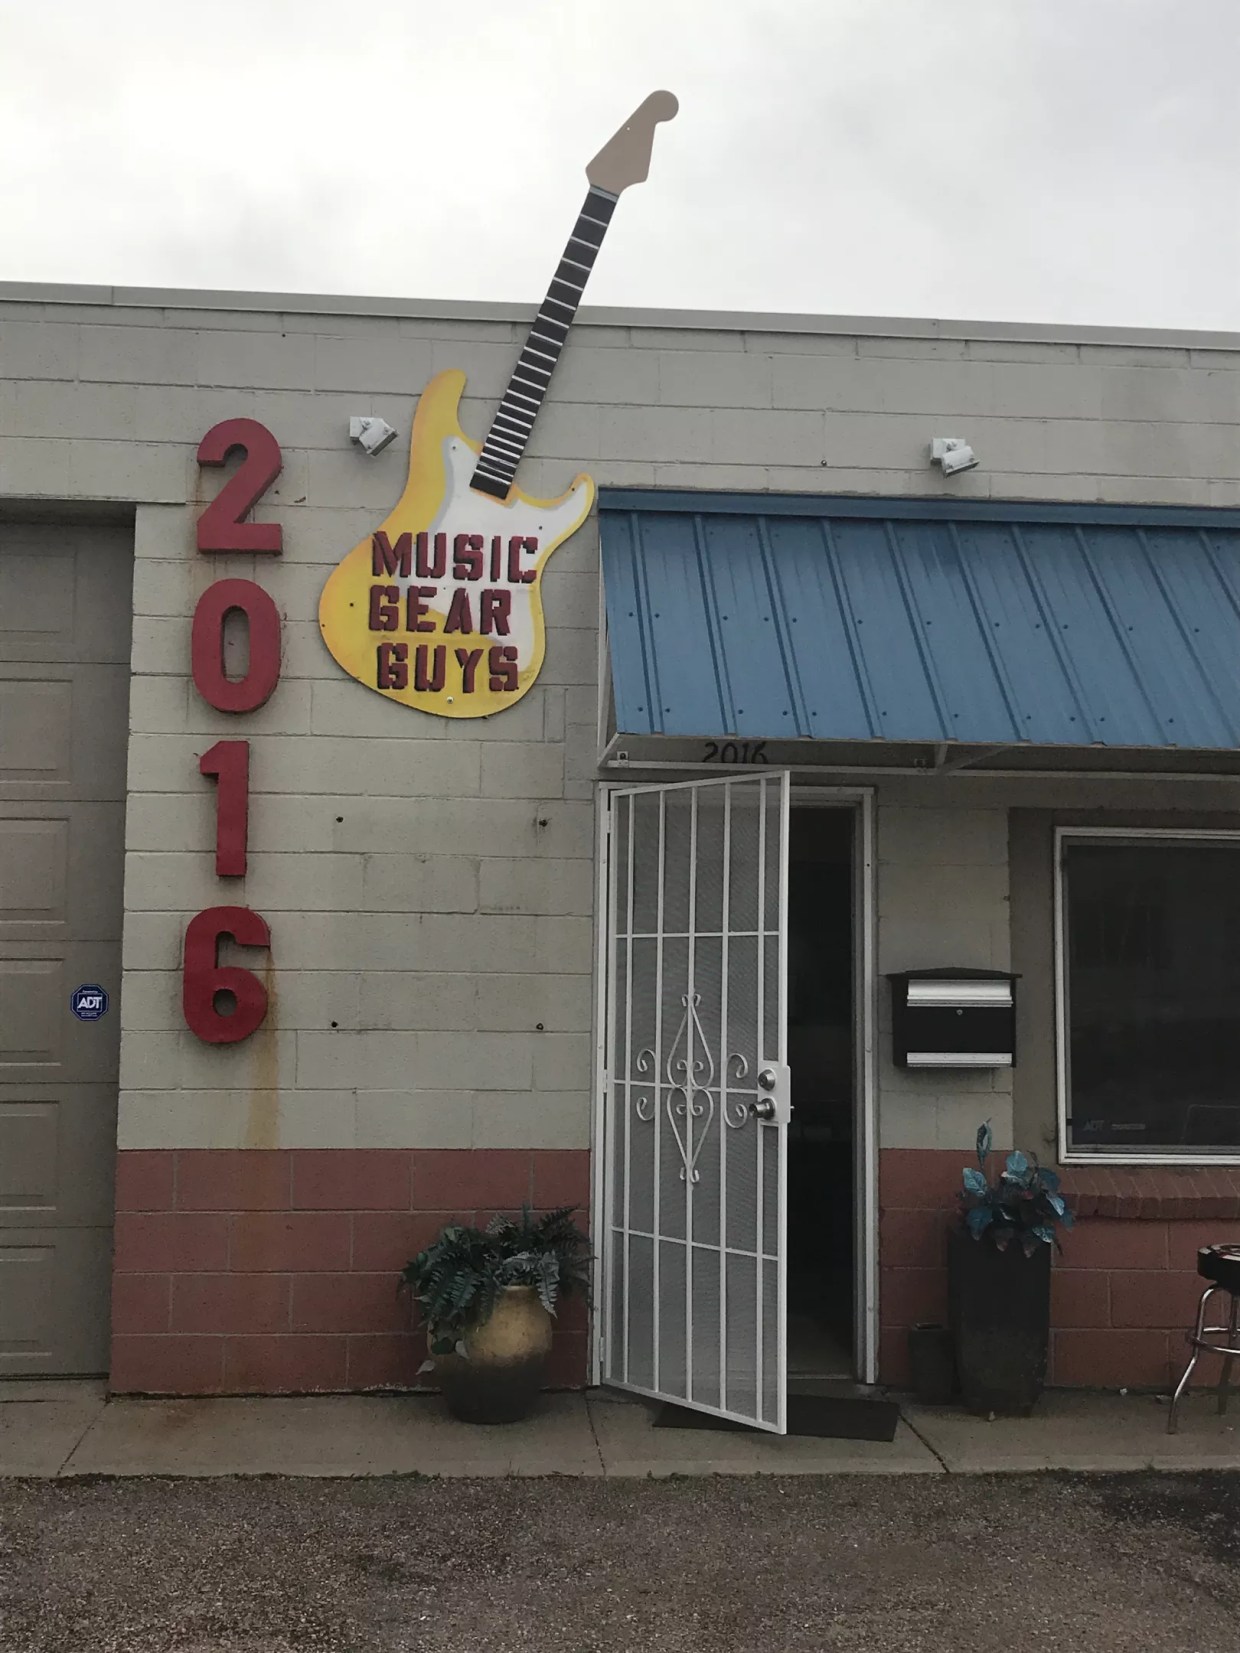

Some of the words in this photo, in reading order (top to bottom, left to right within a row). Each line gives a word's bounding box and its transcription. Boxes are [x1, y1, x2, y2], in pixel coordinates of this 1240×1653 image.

[372, 531, 538, 584] MUSIC
[369, 585, 511, 636] GEAR
[377, 642, 519, 694] GUYS
[183, 417, 283, 1043] 2016
[702, 740, 768, 764] 2016
[77, 996, 103, 1009] ADT
